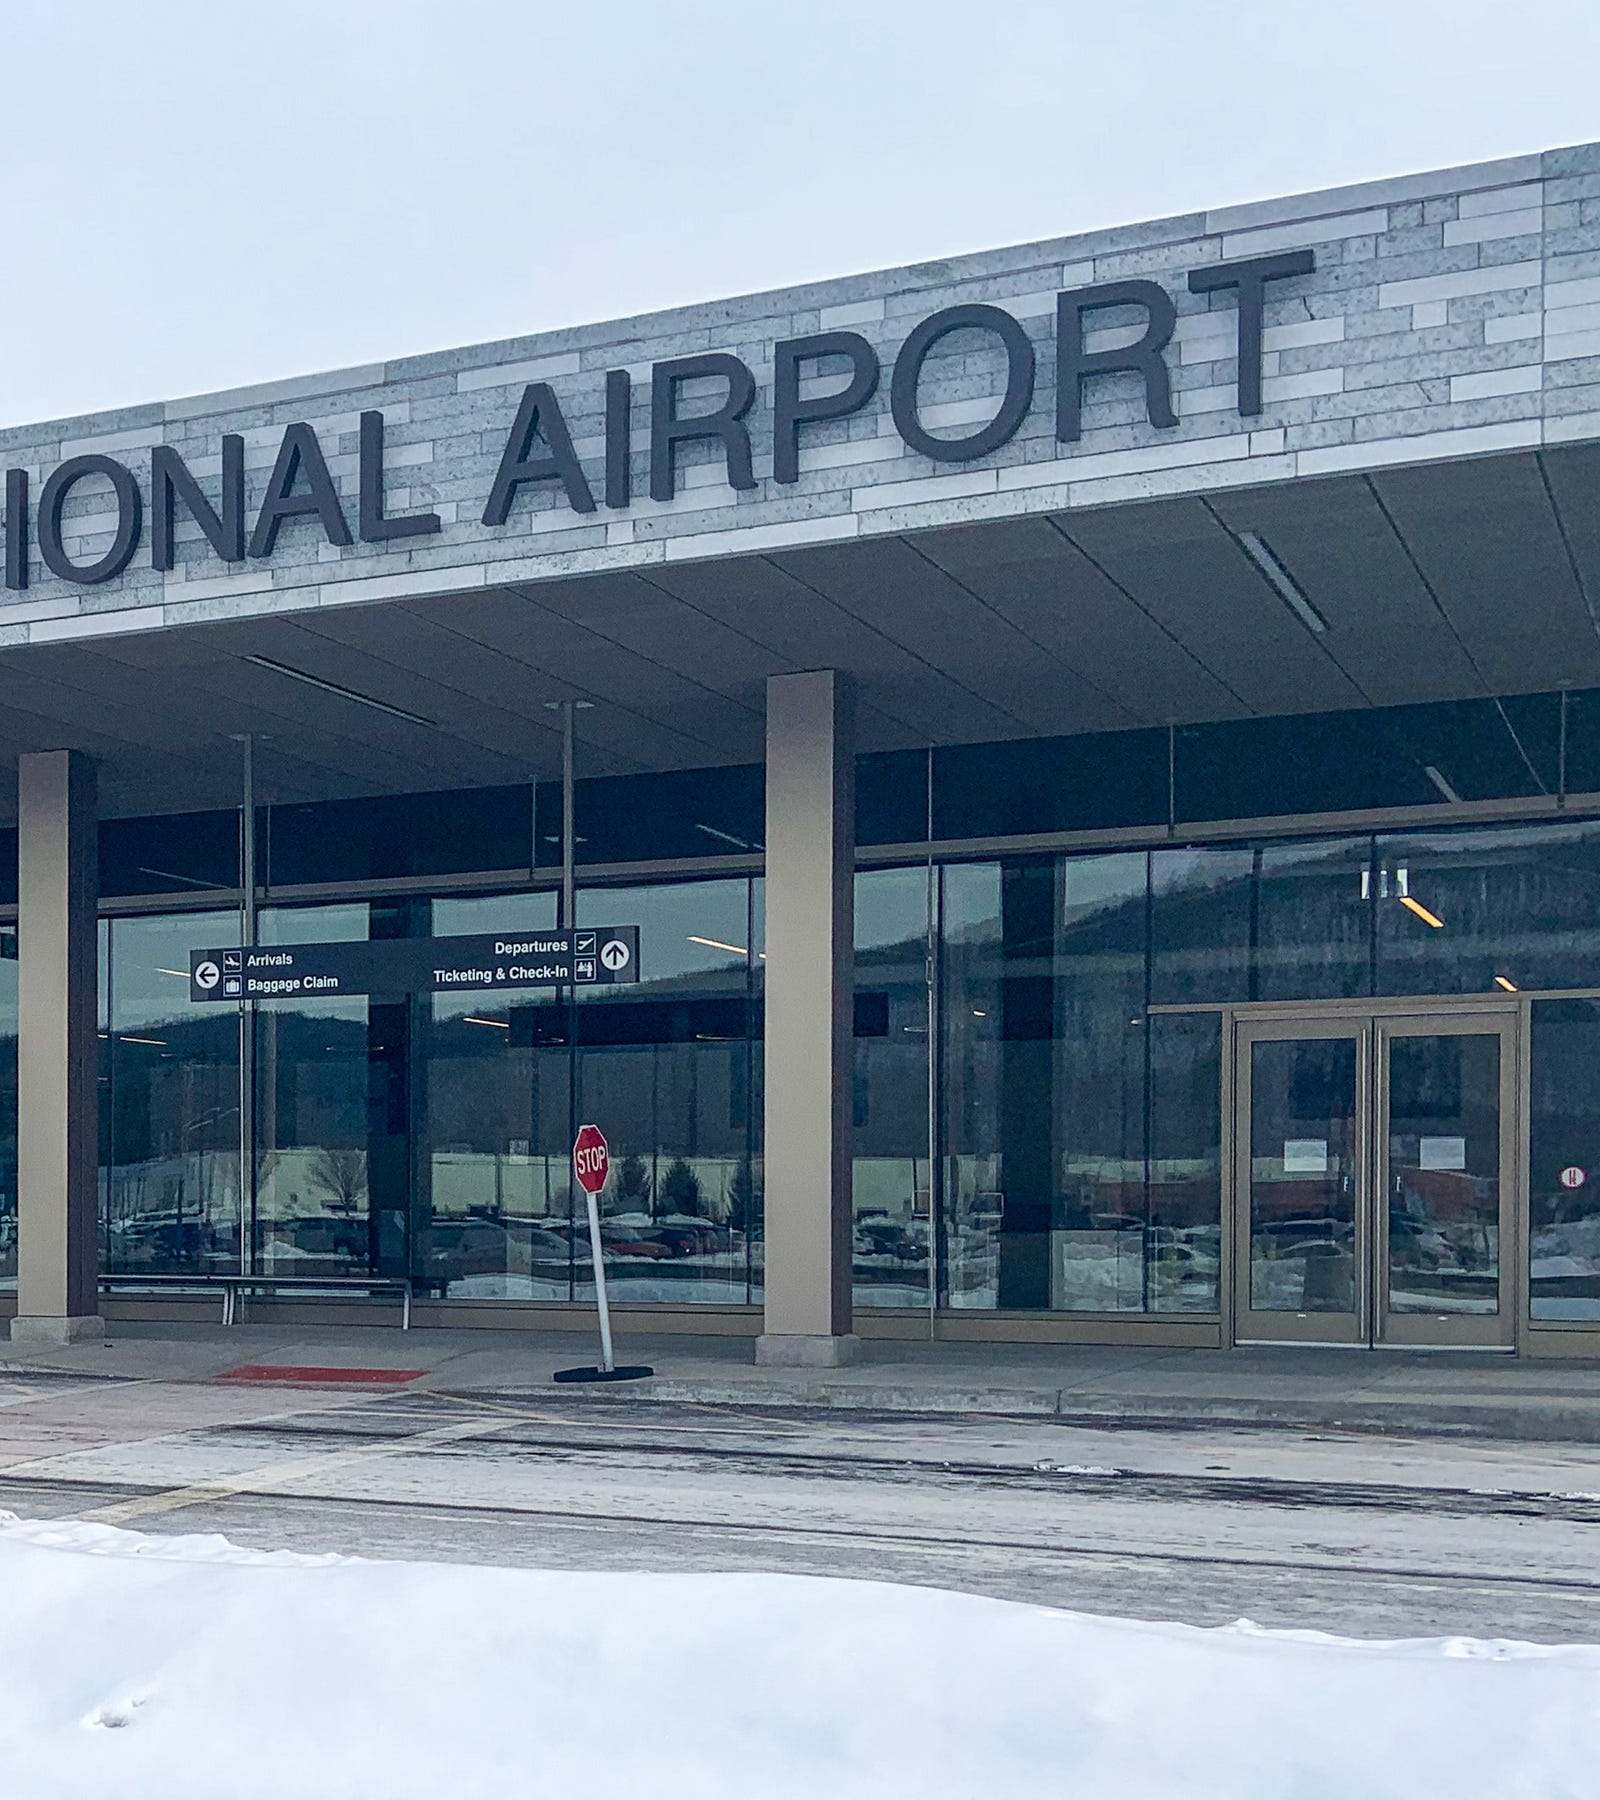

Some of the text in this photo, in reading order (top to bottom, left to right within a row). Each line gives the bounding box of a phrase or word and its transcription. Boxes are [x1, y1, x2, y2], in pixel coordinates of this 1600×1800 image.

[482, 249, 1314, 526] AIRPORT
[495, 939, 568, 957] Departures
[247, 952, 293, 967] Arrivals
[247, 974, 338, 993] Baggage Claim
[433, 965, 568, 984] Ticketing & Check-In
[576, 1145, 606, 1175] STOP
